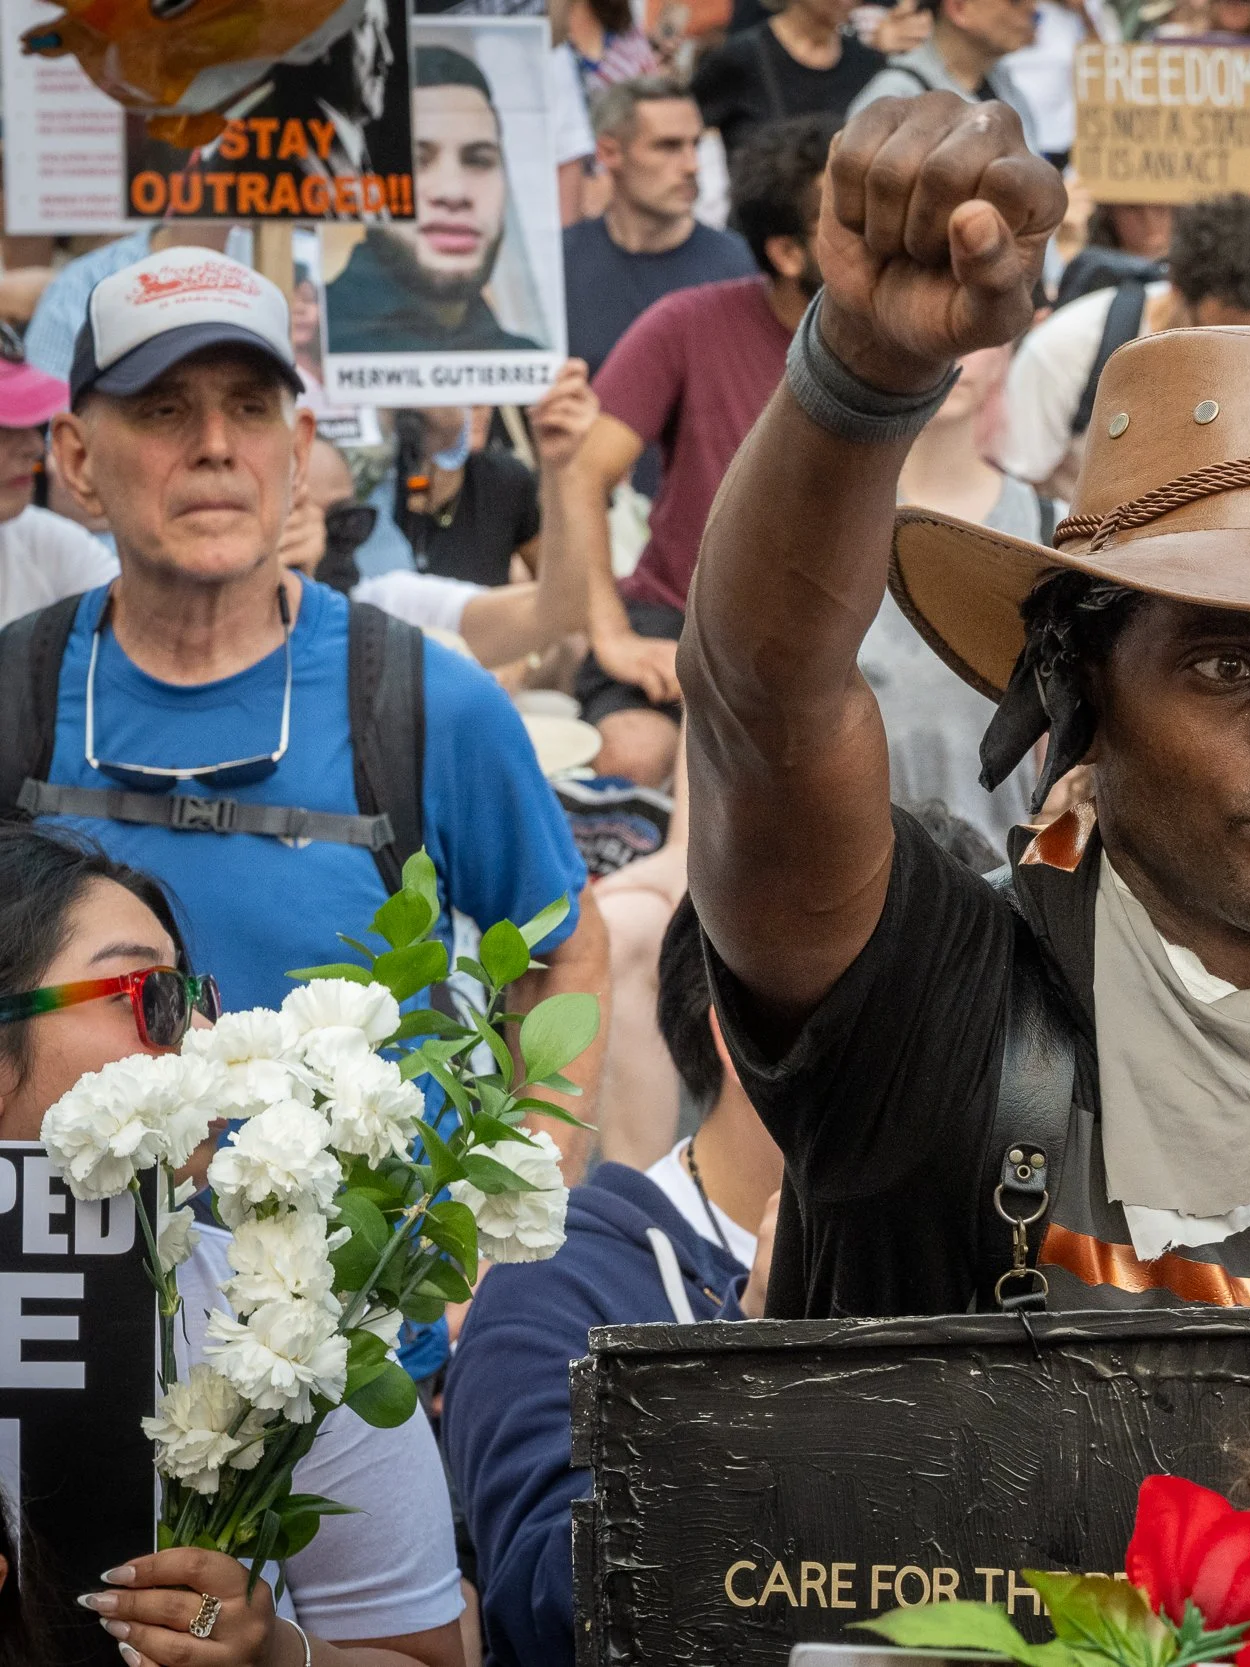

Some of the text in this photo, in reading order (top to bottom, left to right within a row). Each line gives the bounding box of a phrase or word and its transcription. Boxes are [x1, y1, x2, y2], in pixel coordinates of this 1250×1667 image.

[219, 117, 335, 160] STAY
[1112, 106, 1161, 143] NOT
[1165, 108, 1185, 143] A
[130, 170, 412, 216] OUTRAGED!!
[337, 361, 553, 389] MERWIL GUTIERREZ
[724, 1560, 857, 1609] CARE
[871, 1564, 961, 1611] FOR
